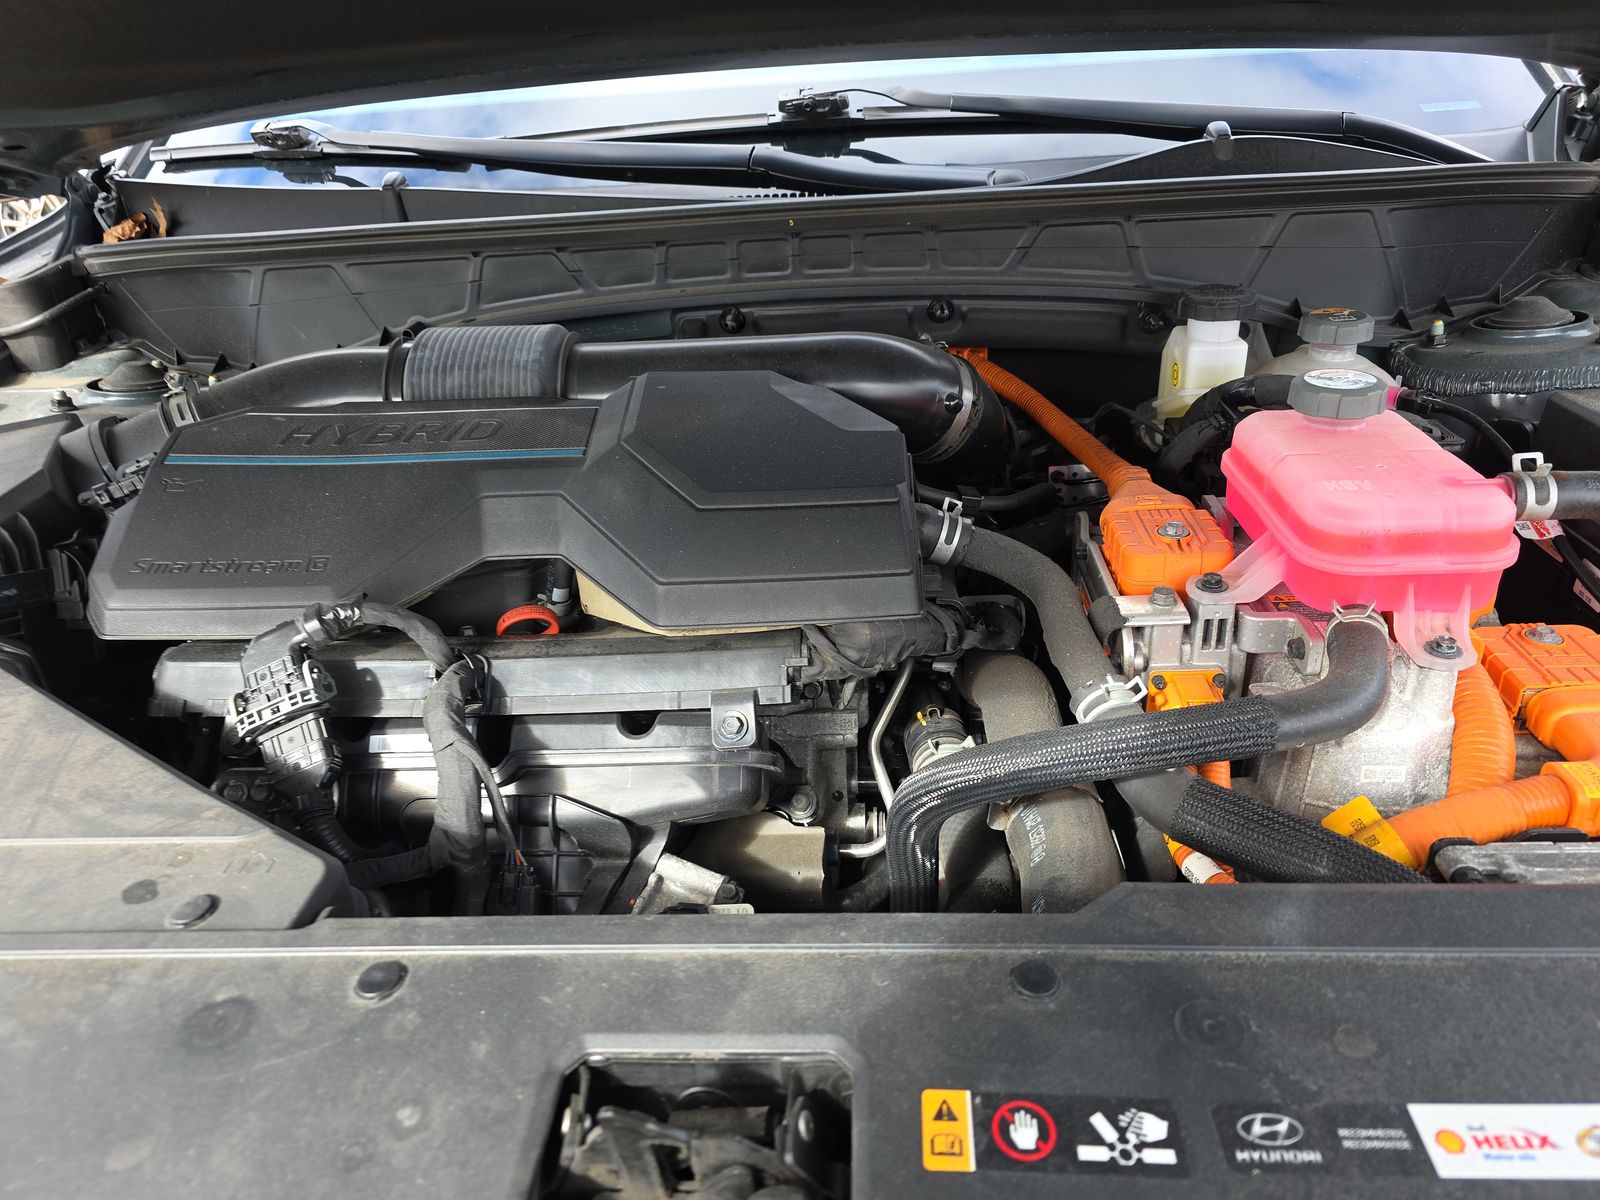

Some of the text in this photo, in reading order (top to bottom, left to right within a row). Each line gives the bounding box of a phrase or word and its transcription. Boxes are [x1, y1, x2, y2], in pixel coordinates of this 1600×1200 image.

[276, 418, 504, 446] HYBRID
[129, 558, 303, 574] Smartstream
[1471, 1135, 1559, 1150] HELIX
[1235, 1149, 1323, 1163] HYUNDAI
